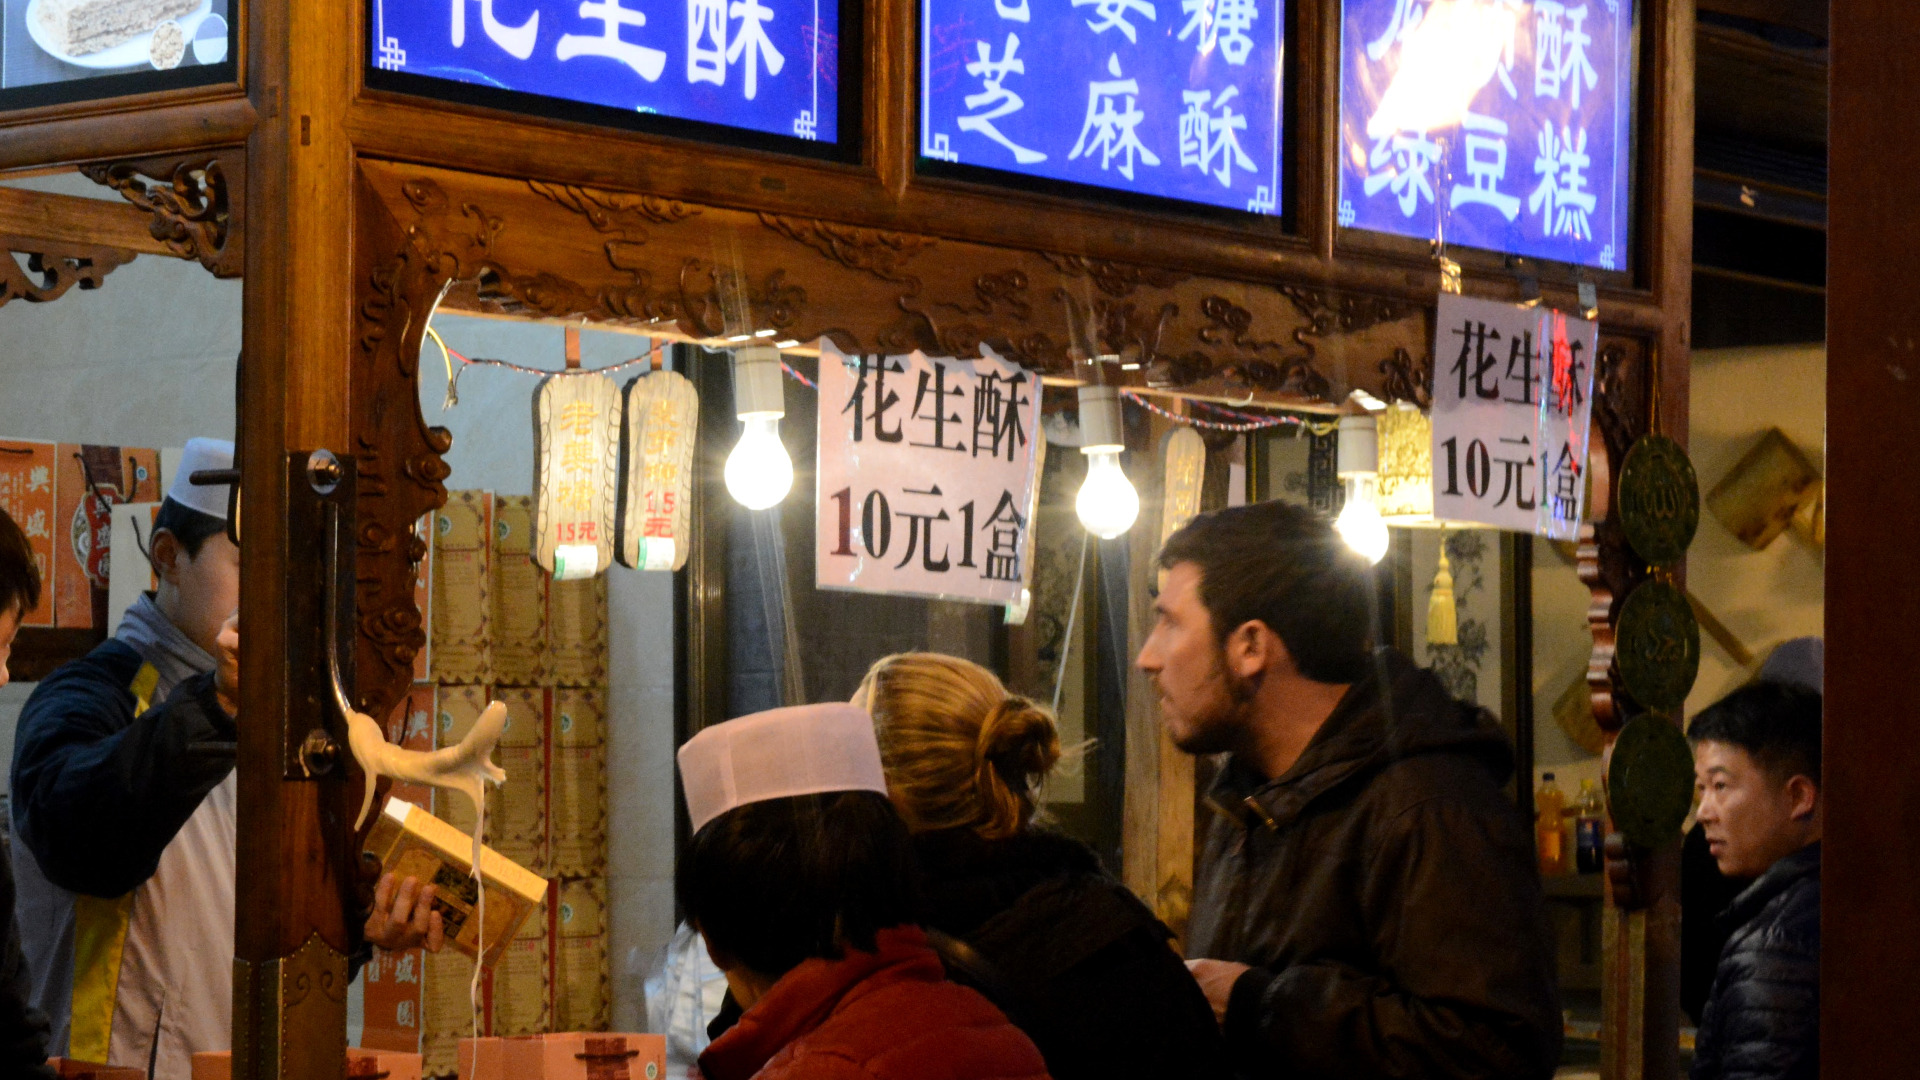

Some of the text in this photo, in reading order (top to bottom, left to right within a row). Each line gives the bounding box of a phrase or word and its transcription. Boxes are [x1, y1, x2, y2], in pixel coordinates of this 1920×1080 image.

[957, 32, 1258, 188] 芝麻酥
[1364, 111, 1598, 242] 绿豆糕
[841, 354, 1030, 462] 花生酥
[555, 521, 598, 542] 15元
[828, 483, 1028, 583] 10元1盒
